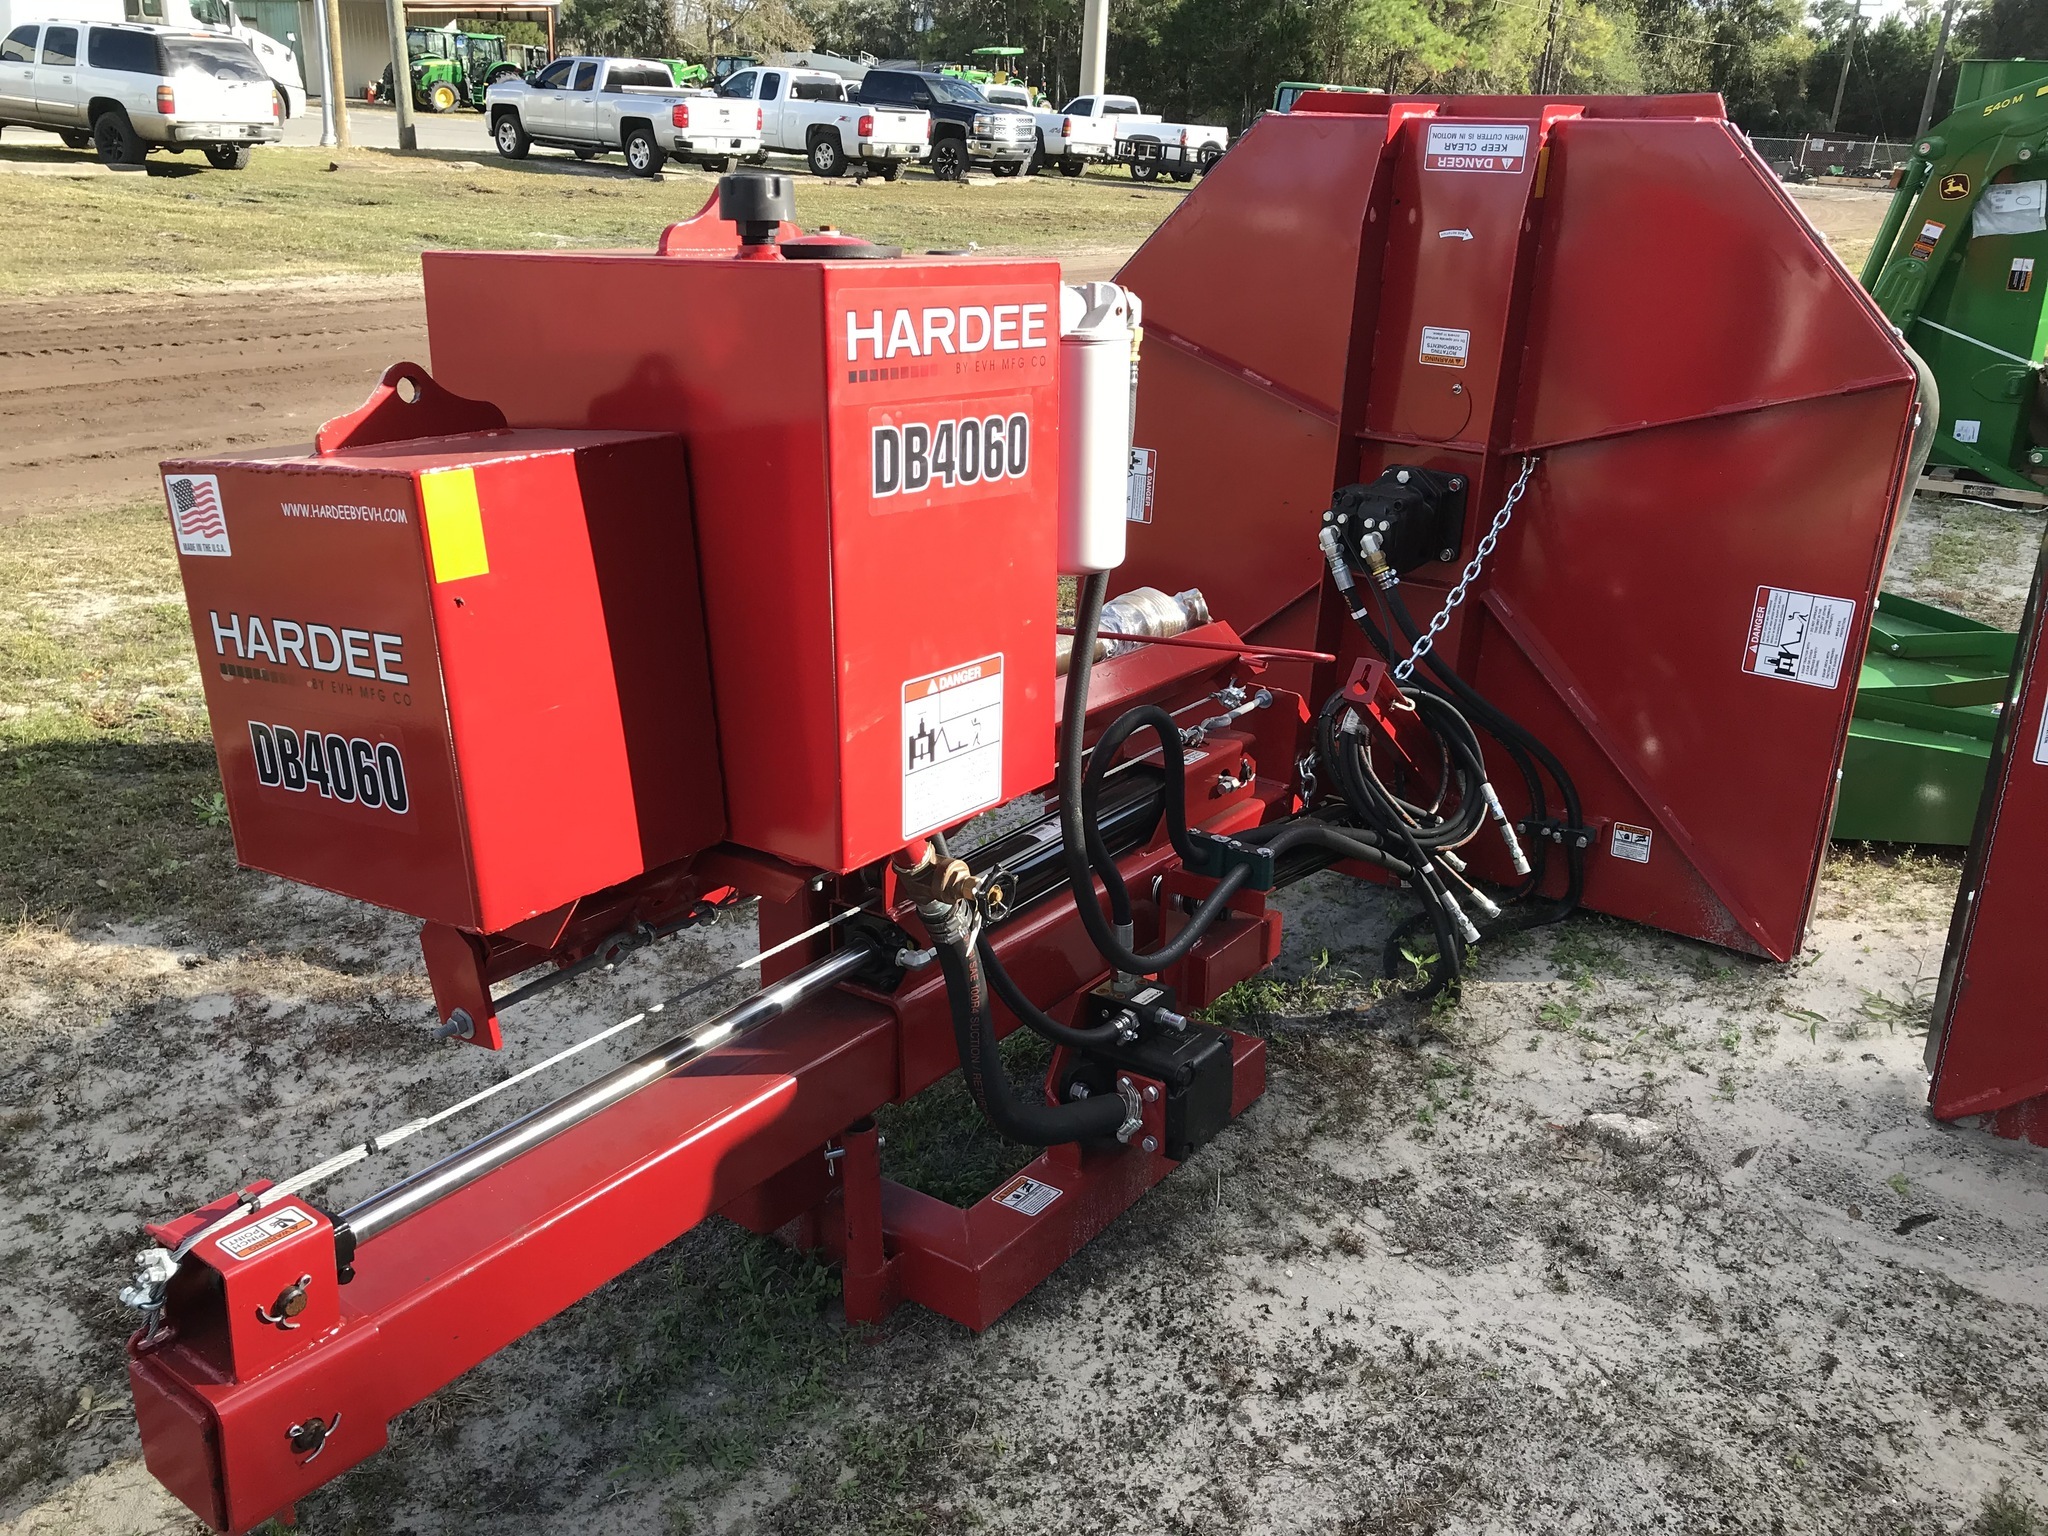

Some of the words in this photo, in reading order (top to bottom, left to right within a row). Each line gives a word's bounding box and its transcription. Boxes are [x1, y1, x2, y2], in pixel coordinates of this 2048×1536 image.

[1983, 99, 2010, 117] 540
[2011, 93, 2024, 105] M
[1444, 143, 1477, 152] CLEAR
[1481, 144, 1508, 152] KEEP
[1437, 157, 1494, 169] DANGER
[846, 303, 1048, 362] HARDEE
[1427, 343, 1462, 351] COMPONENTS
[956, 361, 968, 374] BY
[975, 359, 996, 373] EVH
[1001, 356, 1025, 370] MFG
[1031, 355, 1046, 367] CO
[1424, 355, 1455, 363] WARNING
[872, 412, 1030, 498] DB4060
[1145, 475, 1153, 507] DANGER
[281, 502, 408, 523] WWW.HARDEEBYEVH.COM
[183, 543, 197, 551] MADE
[196, 543, 202, 552] IN
[202, 543, 212, 552] THE
[212, 544, 227, 552] U.S.A.
[1751, 606, 1766, 643] DANGER
[209, 611, 409, 685] HARDEE
[939, 667, 982, 690] DANGER
[312, 678, 325, 691] BY
[332, 681, 353, 696] EVH
[359, 686, 386, 702] MFG
[393, 692, 412, 707] CO
[248, 720, 409, 814] DB4060
[969, 961, 979, 982] SAE
[970, 984, 980, 1014] 100R4
[970, 1016, 981, 1063] SUCTION
[229, 1229, 260, 1246] POINT
[232, 1233, 265, 1250] PINCH
[248, 1231, 291, 1251] WARNING
